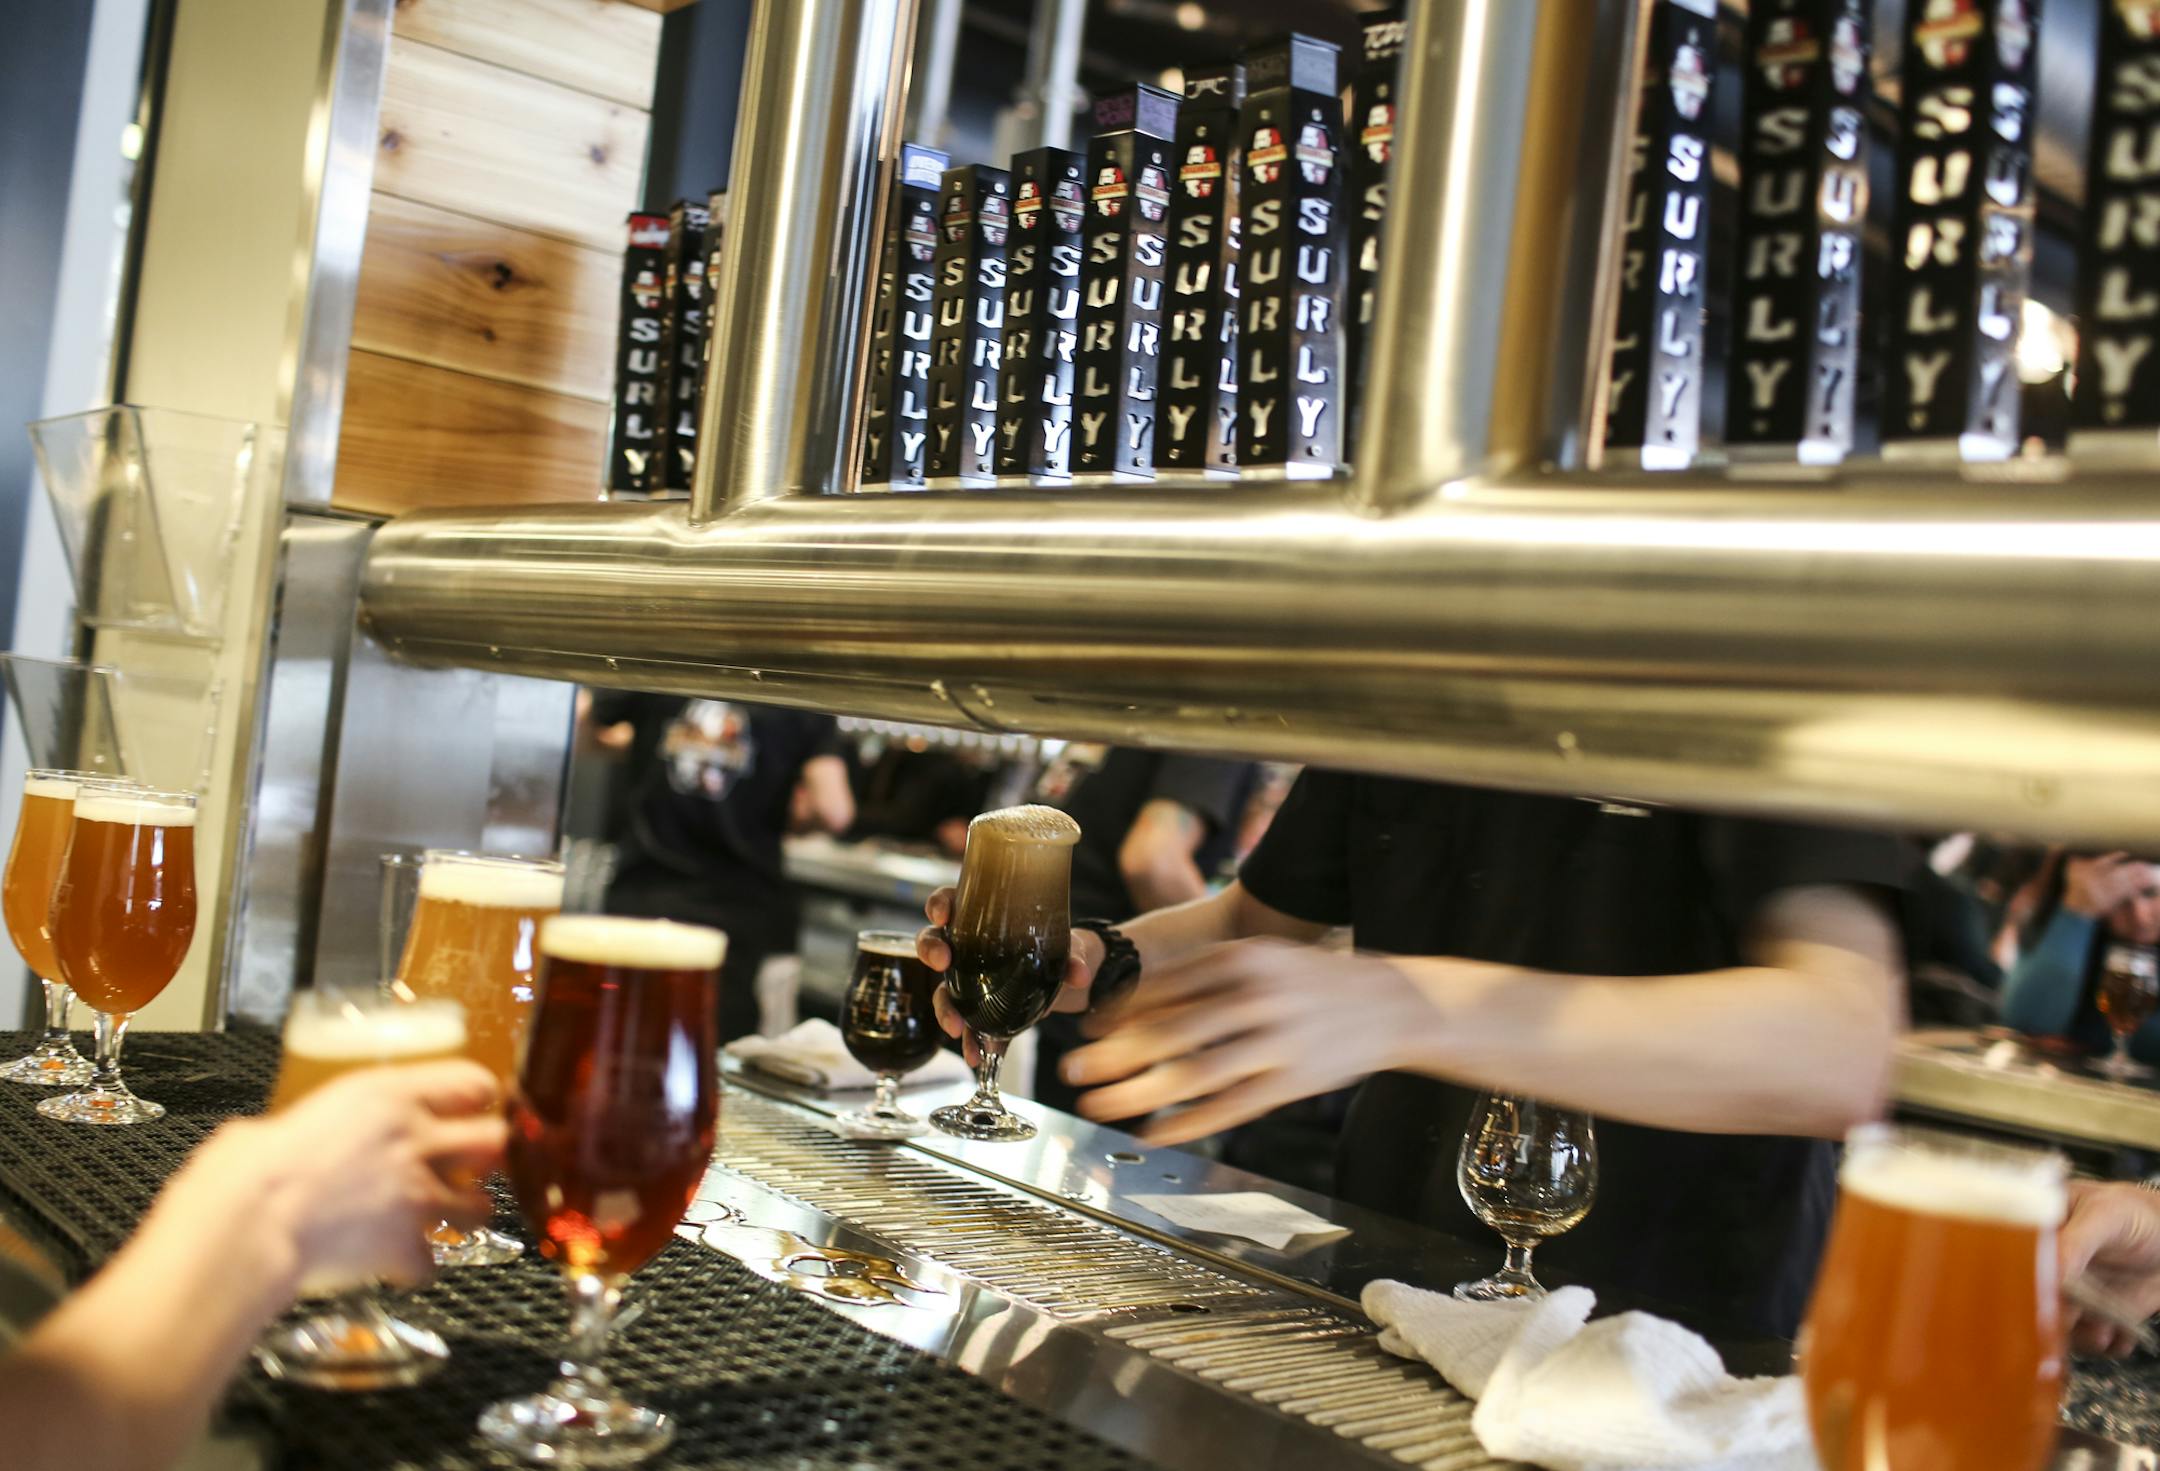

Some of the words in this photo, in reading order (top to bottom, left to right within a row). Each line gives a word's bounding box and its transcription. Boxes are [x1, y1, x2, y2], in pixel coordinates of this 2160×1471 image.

[1002, 245, 1036, 448] SURLY
[1042, 244, 1082, 453] SURLY
[1081, 231, 1120, 447] SURLY
[1126, 233, 1165, 449] SURLY
[1168, 214, 1212, 442] SURLY
[1249, 200, 1282, 438] SURLY
[1296, 197, 1332, 438] SURLY
[1660, 134, 1703, 418] SURLY
[1746, 108, 1808, 410] SURLY
[1818, 107, 1861, 411] SURLY
[1905, 86, 1974, 404] SURLY
[624, 317, 660, 475] SURLY
[901, 273, 935, 463] SURLY
[937, 257, 966, 453] SURLY
[972, 257, 1007, 456] SURLY
